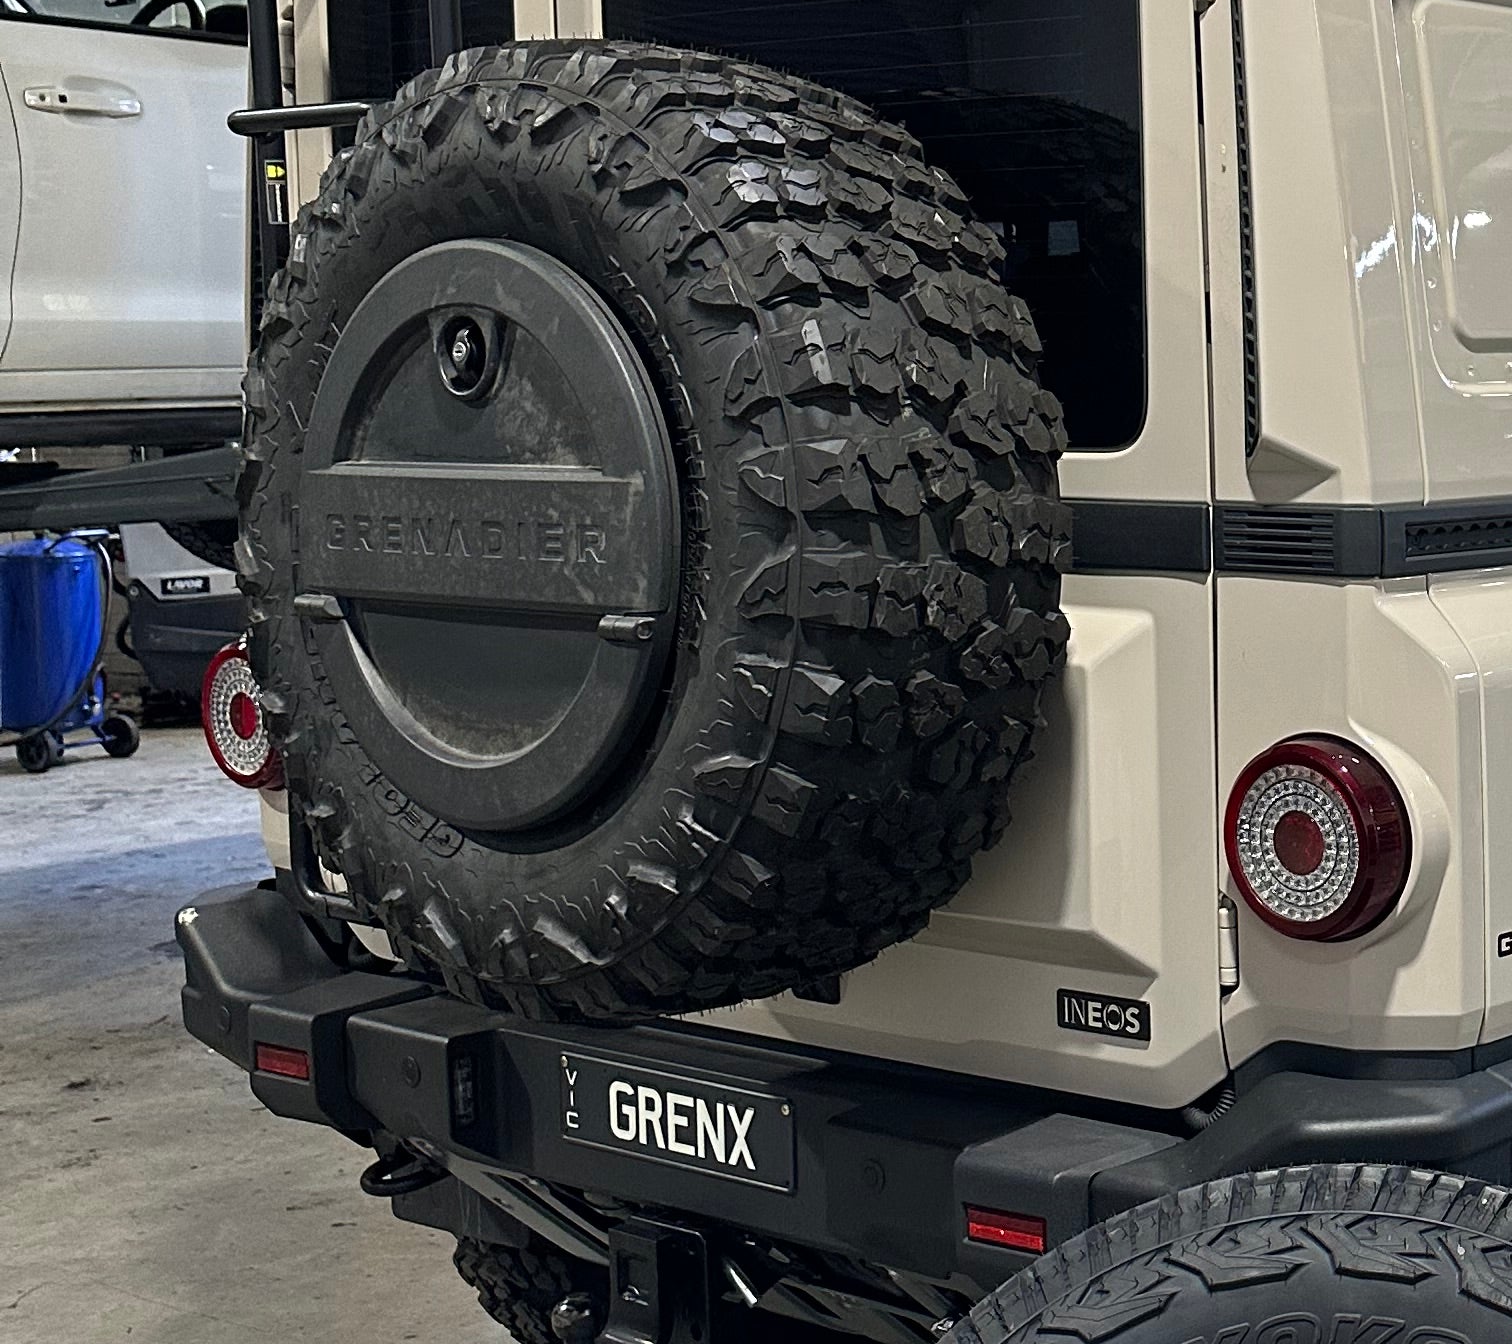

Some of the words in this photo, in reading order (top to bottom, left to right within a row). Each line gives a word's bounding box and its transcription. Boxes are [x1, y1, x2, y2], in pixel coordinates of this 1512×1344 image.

[325, 513, 607, 565] GRENADIER
[1063, 995, 1141, 1034] INEOS
[565, 1068, 580, 1129] VIC
[608, 1080, 757, 1171] GRENX
